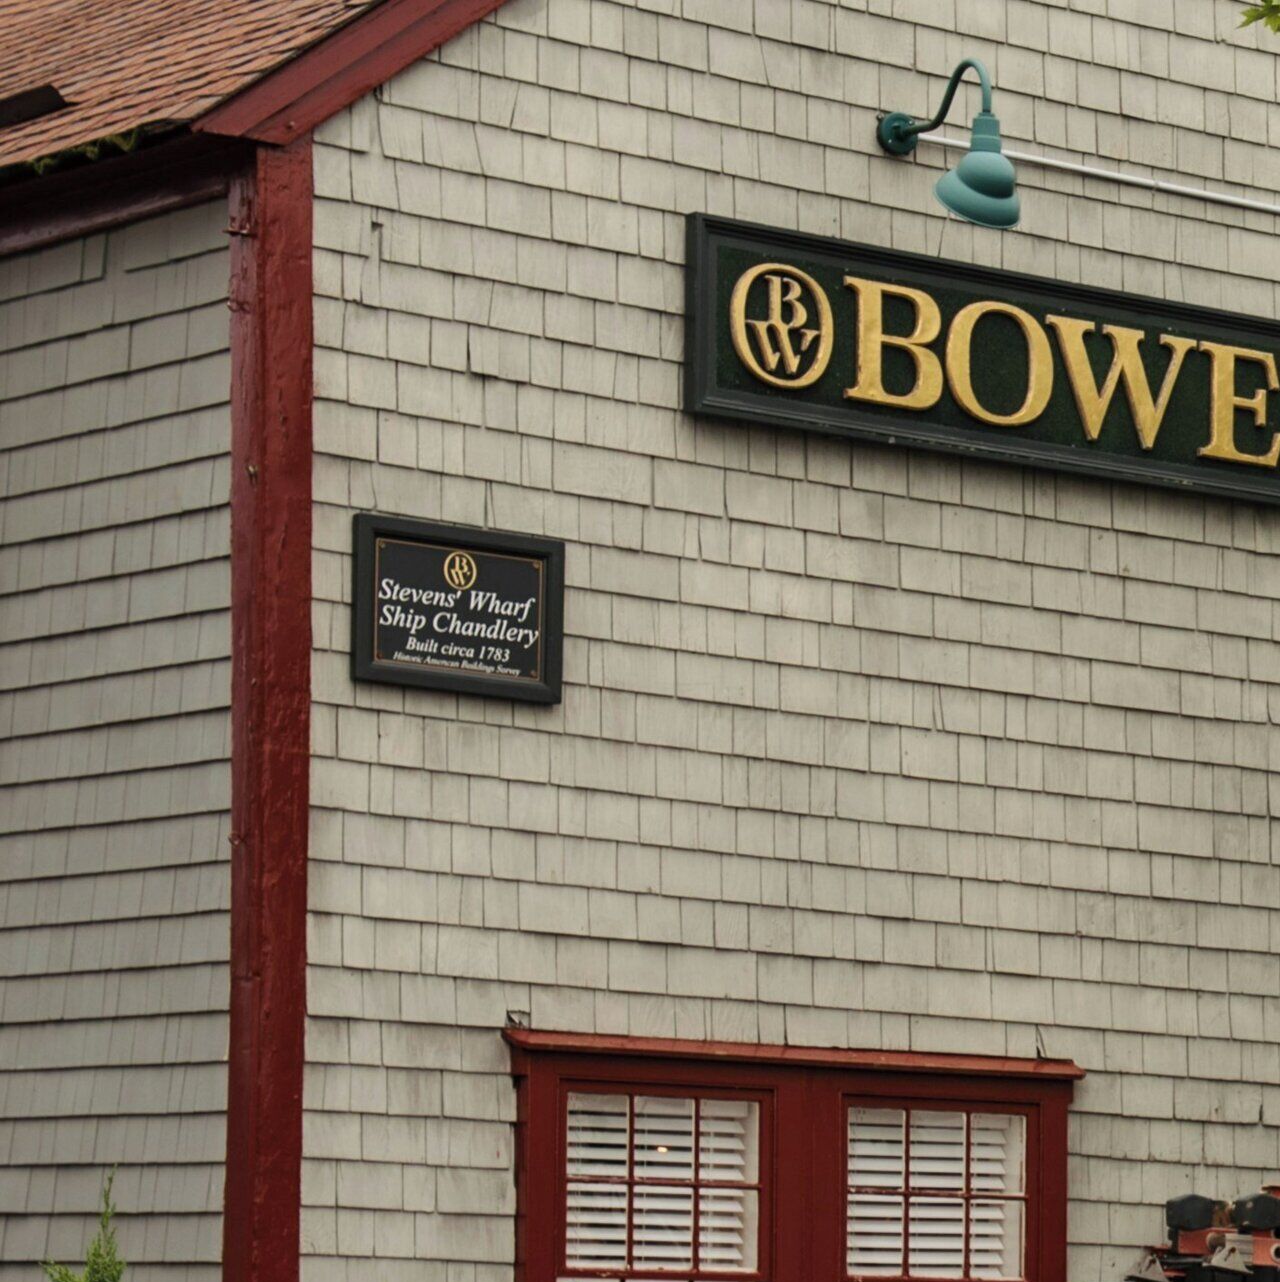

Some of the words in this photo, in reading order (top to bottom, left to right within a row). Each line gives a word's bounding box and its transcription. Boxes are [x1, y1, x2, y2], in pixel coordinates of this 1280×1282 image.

[378, 578, 463, 609] Stevens'
[470, 591, 535, 622] Wharf
[379, 604, 427, 635] Ship
[432, 612, 540, 649] Chandlery
[393, 650, 423, 664] Historic
[423, 655, 460, 668] American
[460, 659, 495, 674] Buildings
[495, 664, 521, 677] Survey
[405, 636, 438, 655] Built
[441, 643, 475, 659] circa
[479, 646, 511, 662] 1783
